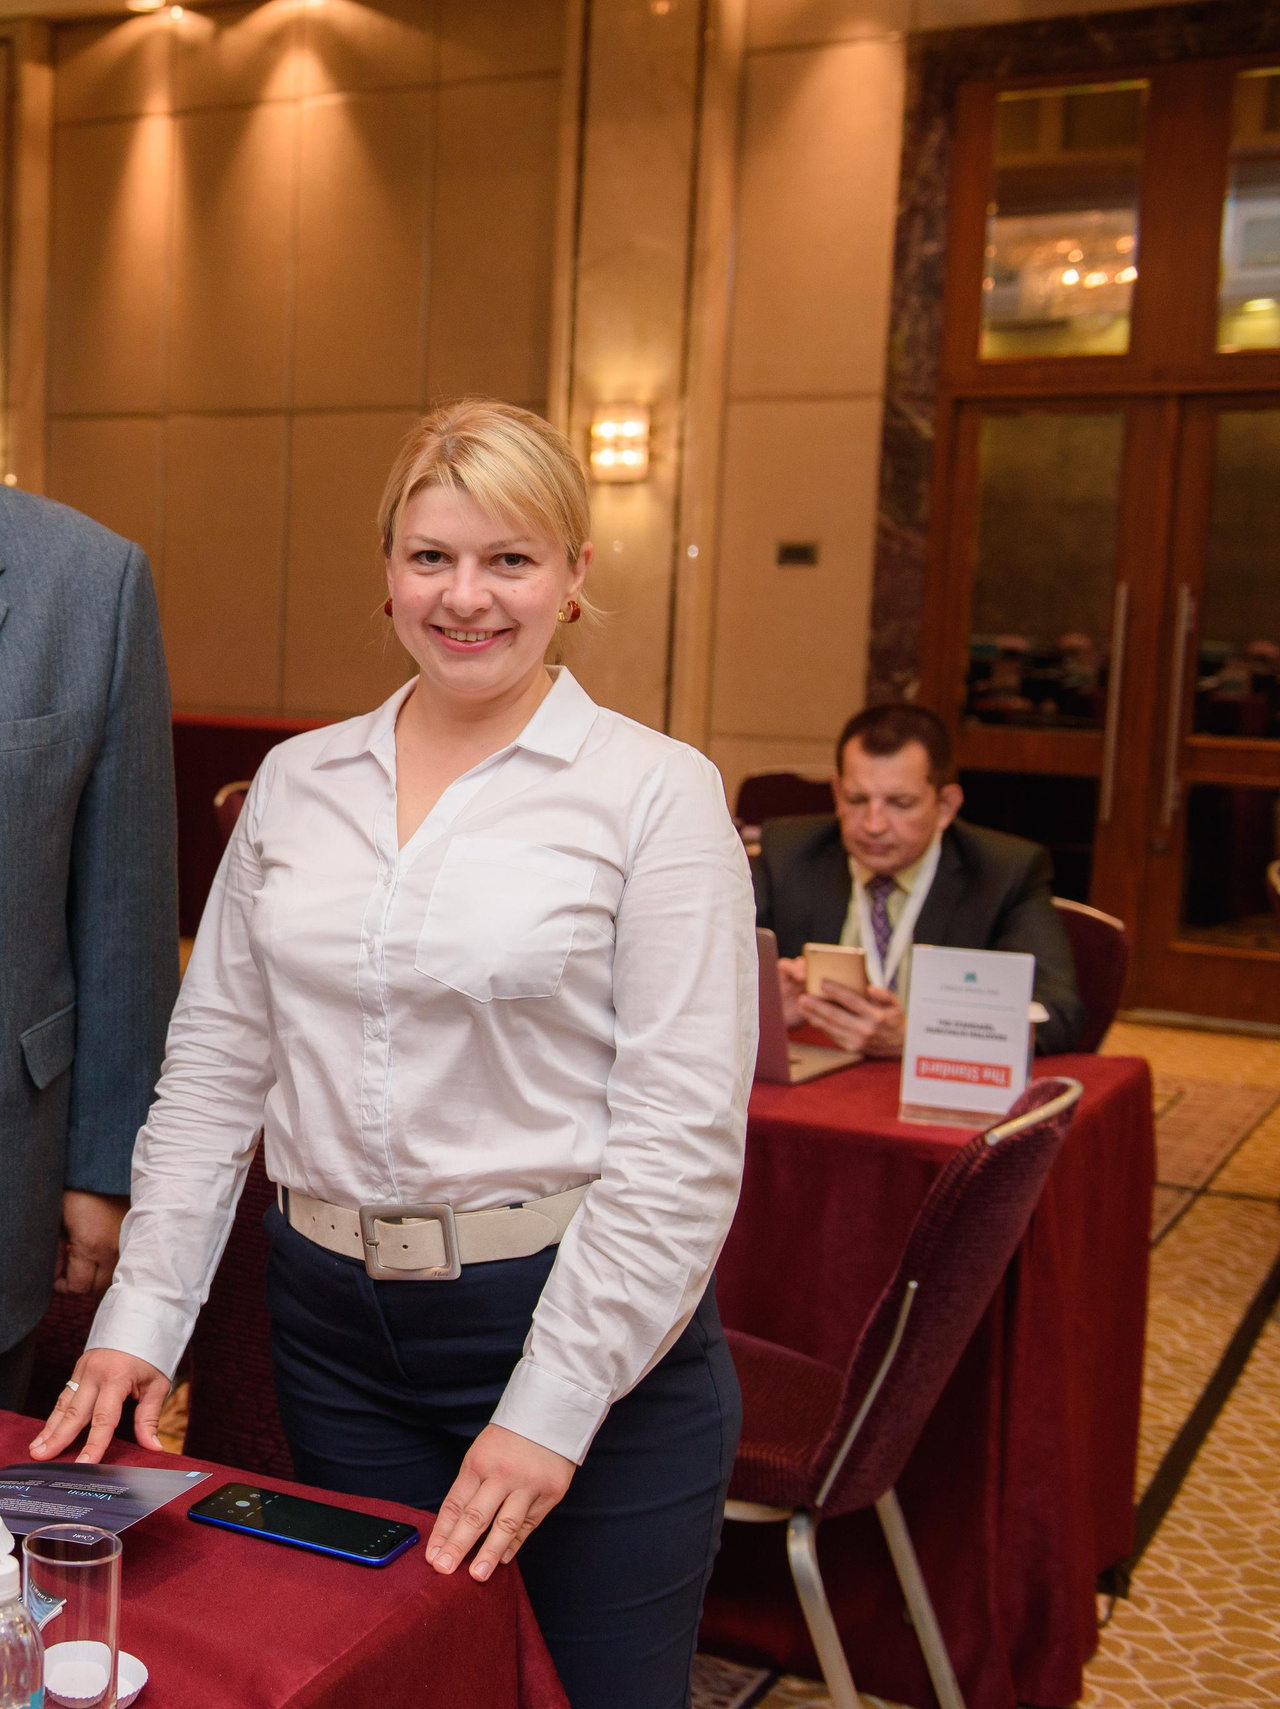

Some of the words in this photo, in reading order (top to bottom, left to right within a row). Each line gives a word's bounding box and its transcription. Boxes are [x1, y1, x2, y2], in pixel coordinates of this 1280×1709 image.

[921, 1060, 979, 1080] Standard
[983, 1067, 1006, 1084] The
[67, 1488, 115, 1501] Mission
